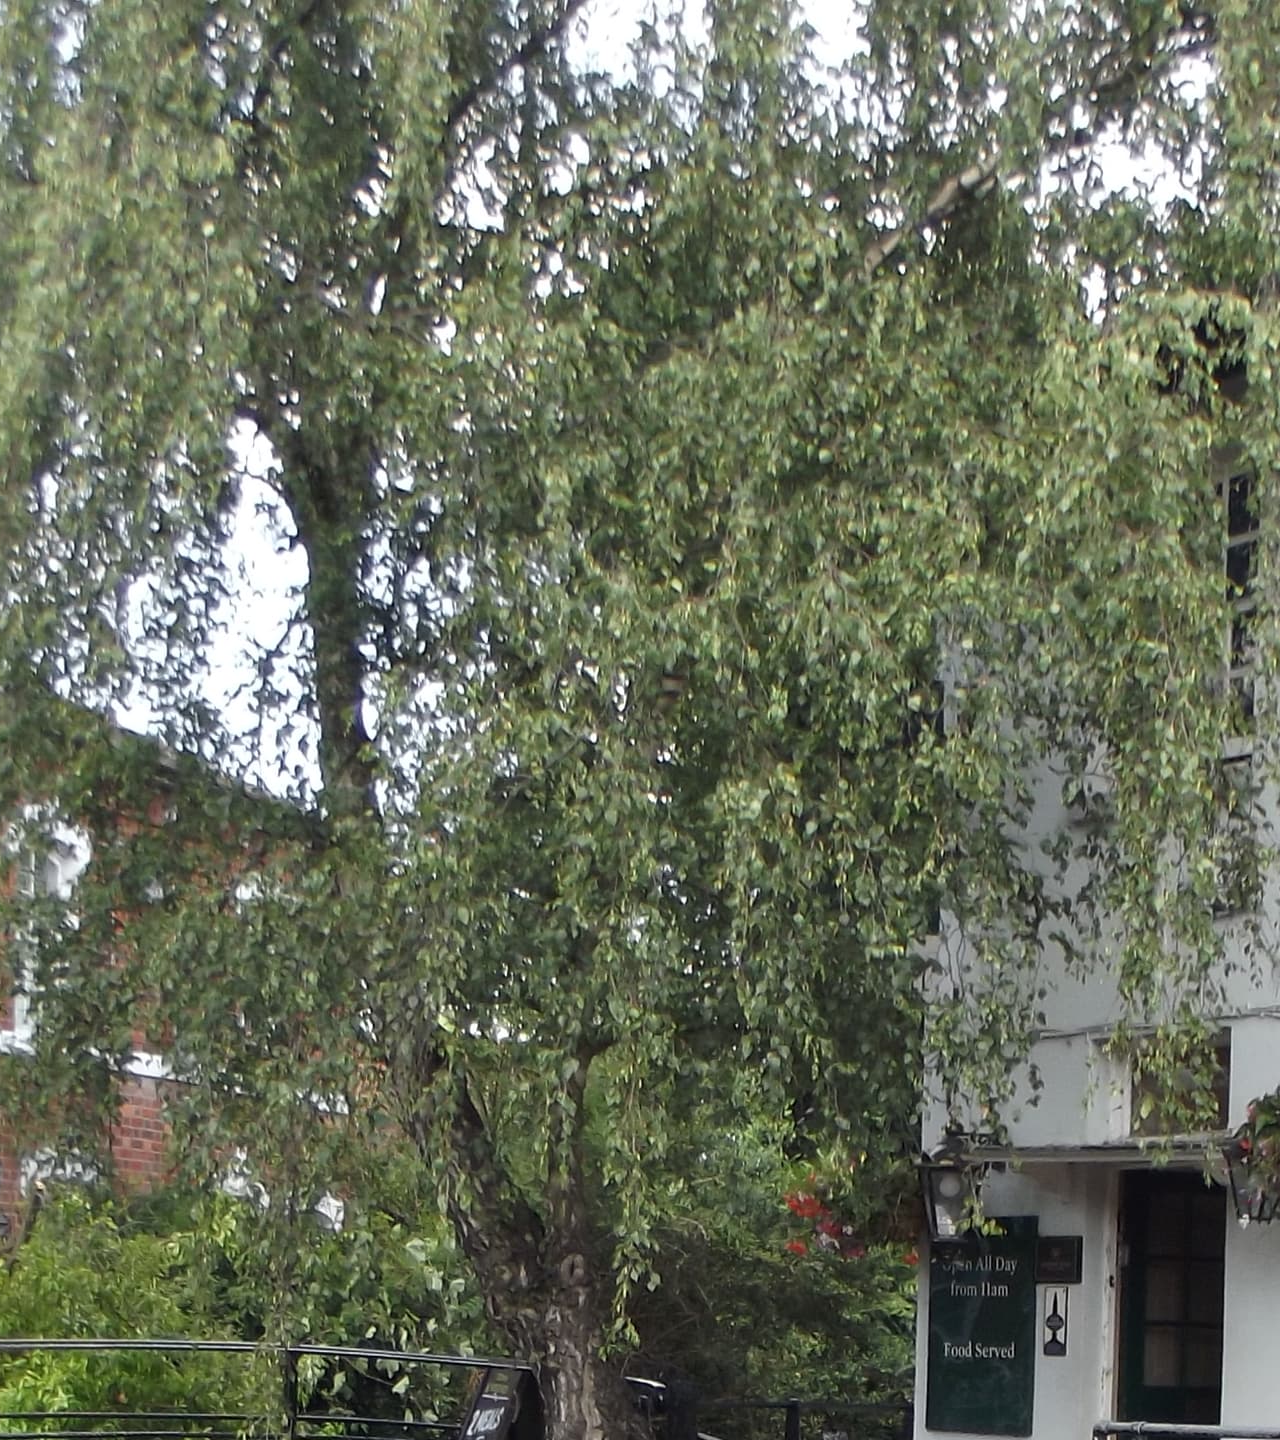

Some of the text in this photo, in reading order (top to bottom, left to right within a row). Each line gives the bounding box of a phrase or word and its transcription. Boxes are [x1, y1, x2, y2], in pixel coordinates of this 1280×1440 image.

[976, 1256, 992, 1272] All
[995, 1256, 1018, 1276] Day
[950, 1280, 977, 1297] from
[943, 1341, 1015, 1359] Food Served
